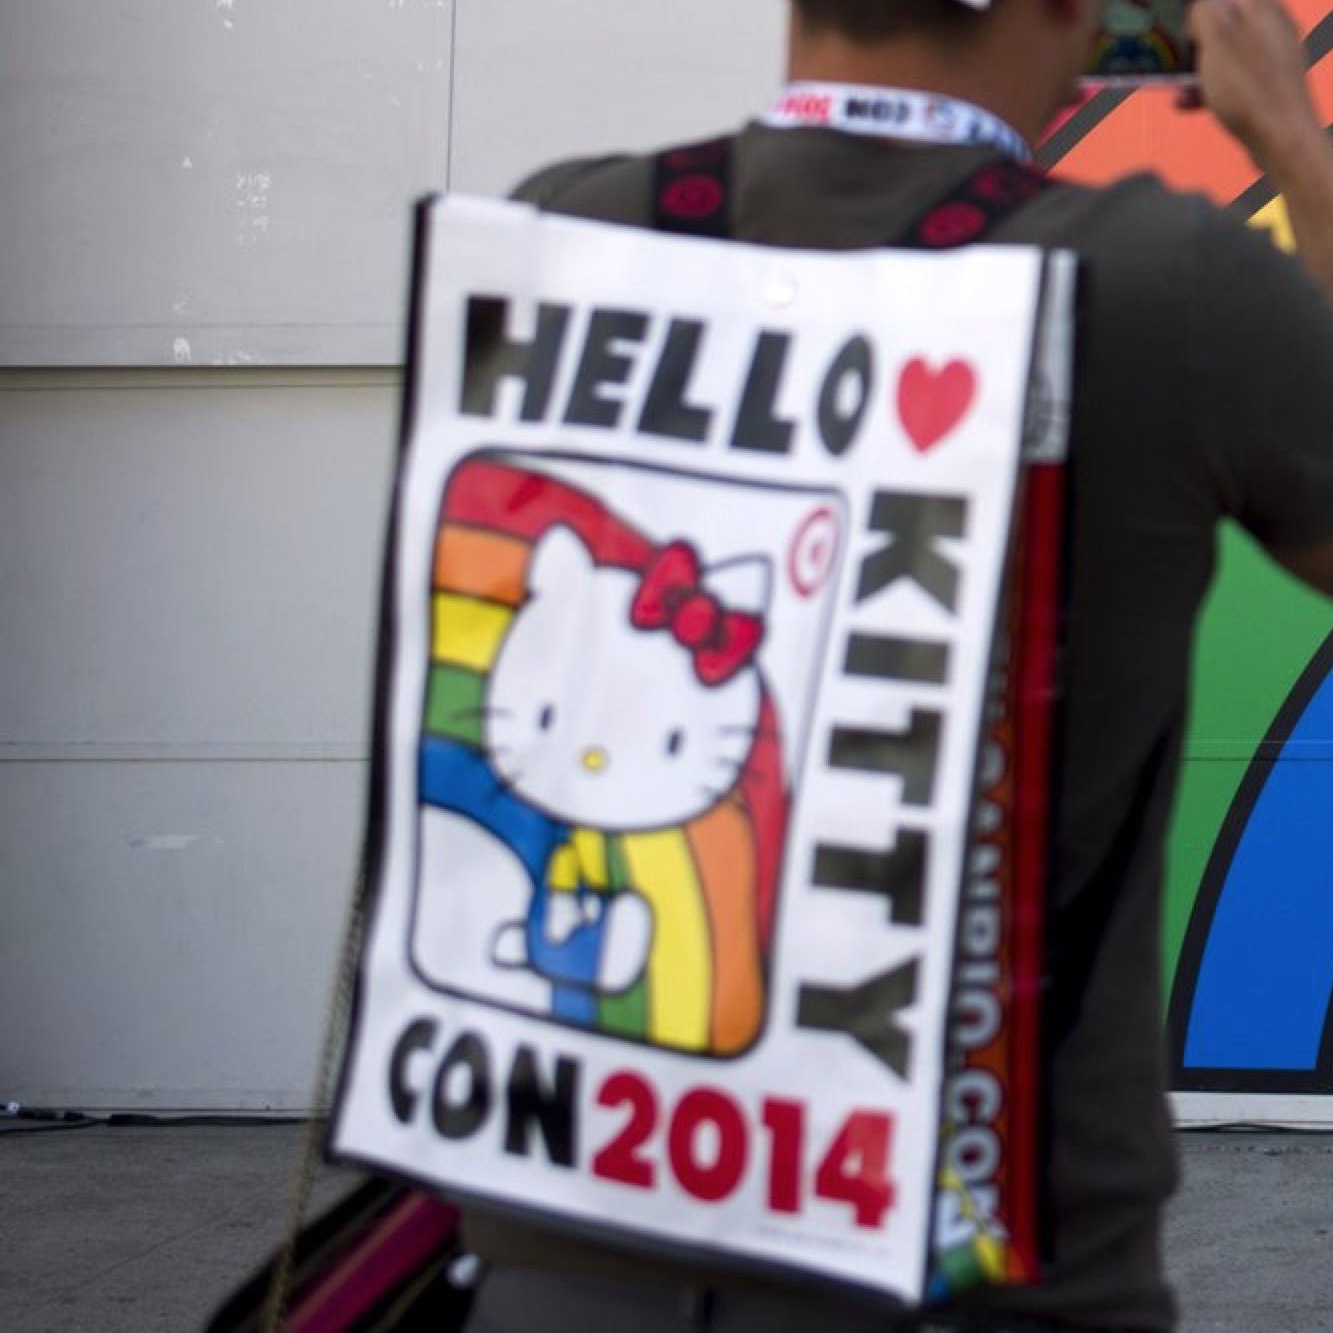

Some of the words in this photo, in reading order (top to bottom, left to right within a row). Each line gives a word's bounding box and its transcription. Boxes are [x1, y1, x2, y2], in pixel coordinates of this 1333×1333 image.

[460, 295, 877, 457] HELLO
[796, 490, 969, 1080] KITTY
[388, 1017, 580, 1169] CON
[593, 1069, 895, 1229] 2014
